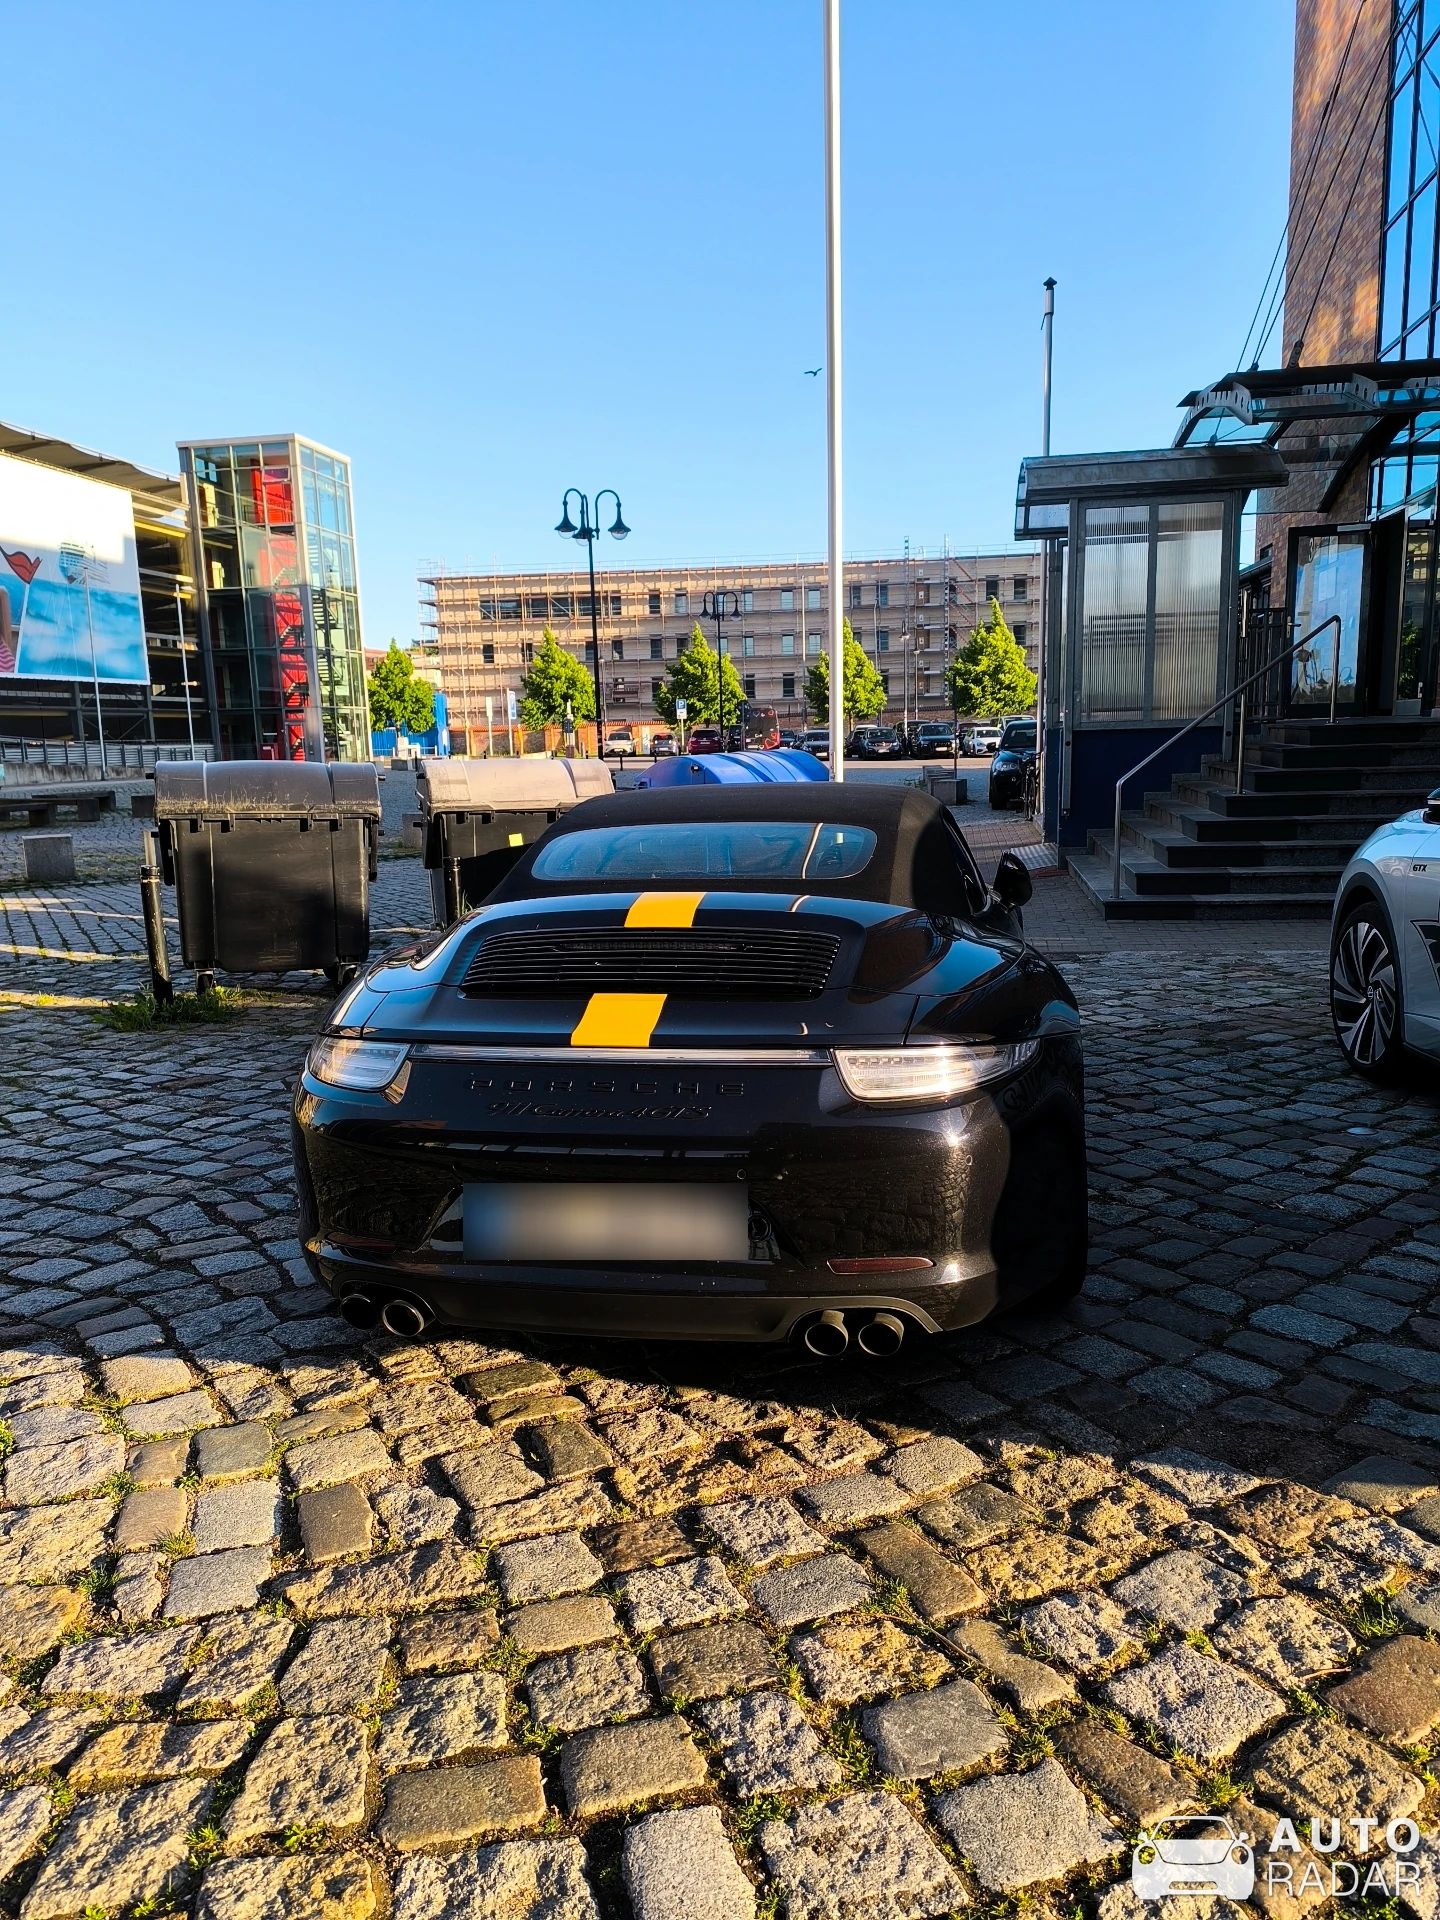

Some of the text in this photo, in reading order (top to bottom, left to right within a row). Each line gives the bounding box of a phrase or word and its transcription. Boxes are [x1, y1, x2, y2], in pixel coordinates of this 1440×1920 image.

[678, 700, 685, 709] P
[1412, 864, 1428, 872] GTX
[469, 1078, 745, 1096] PORSCHE
[488, 1101, 532, 1117] 911
[532, 1103, 625, 1120] Carrera
